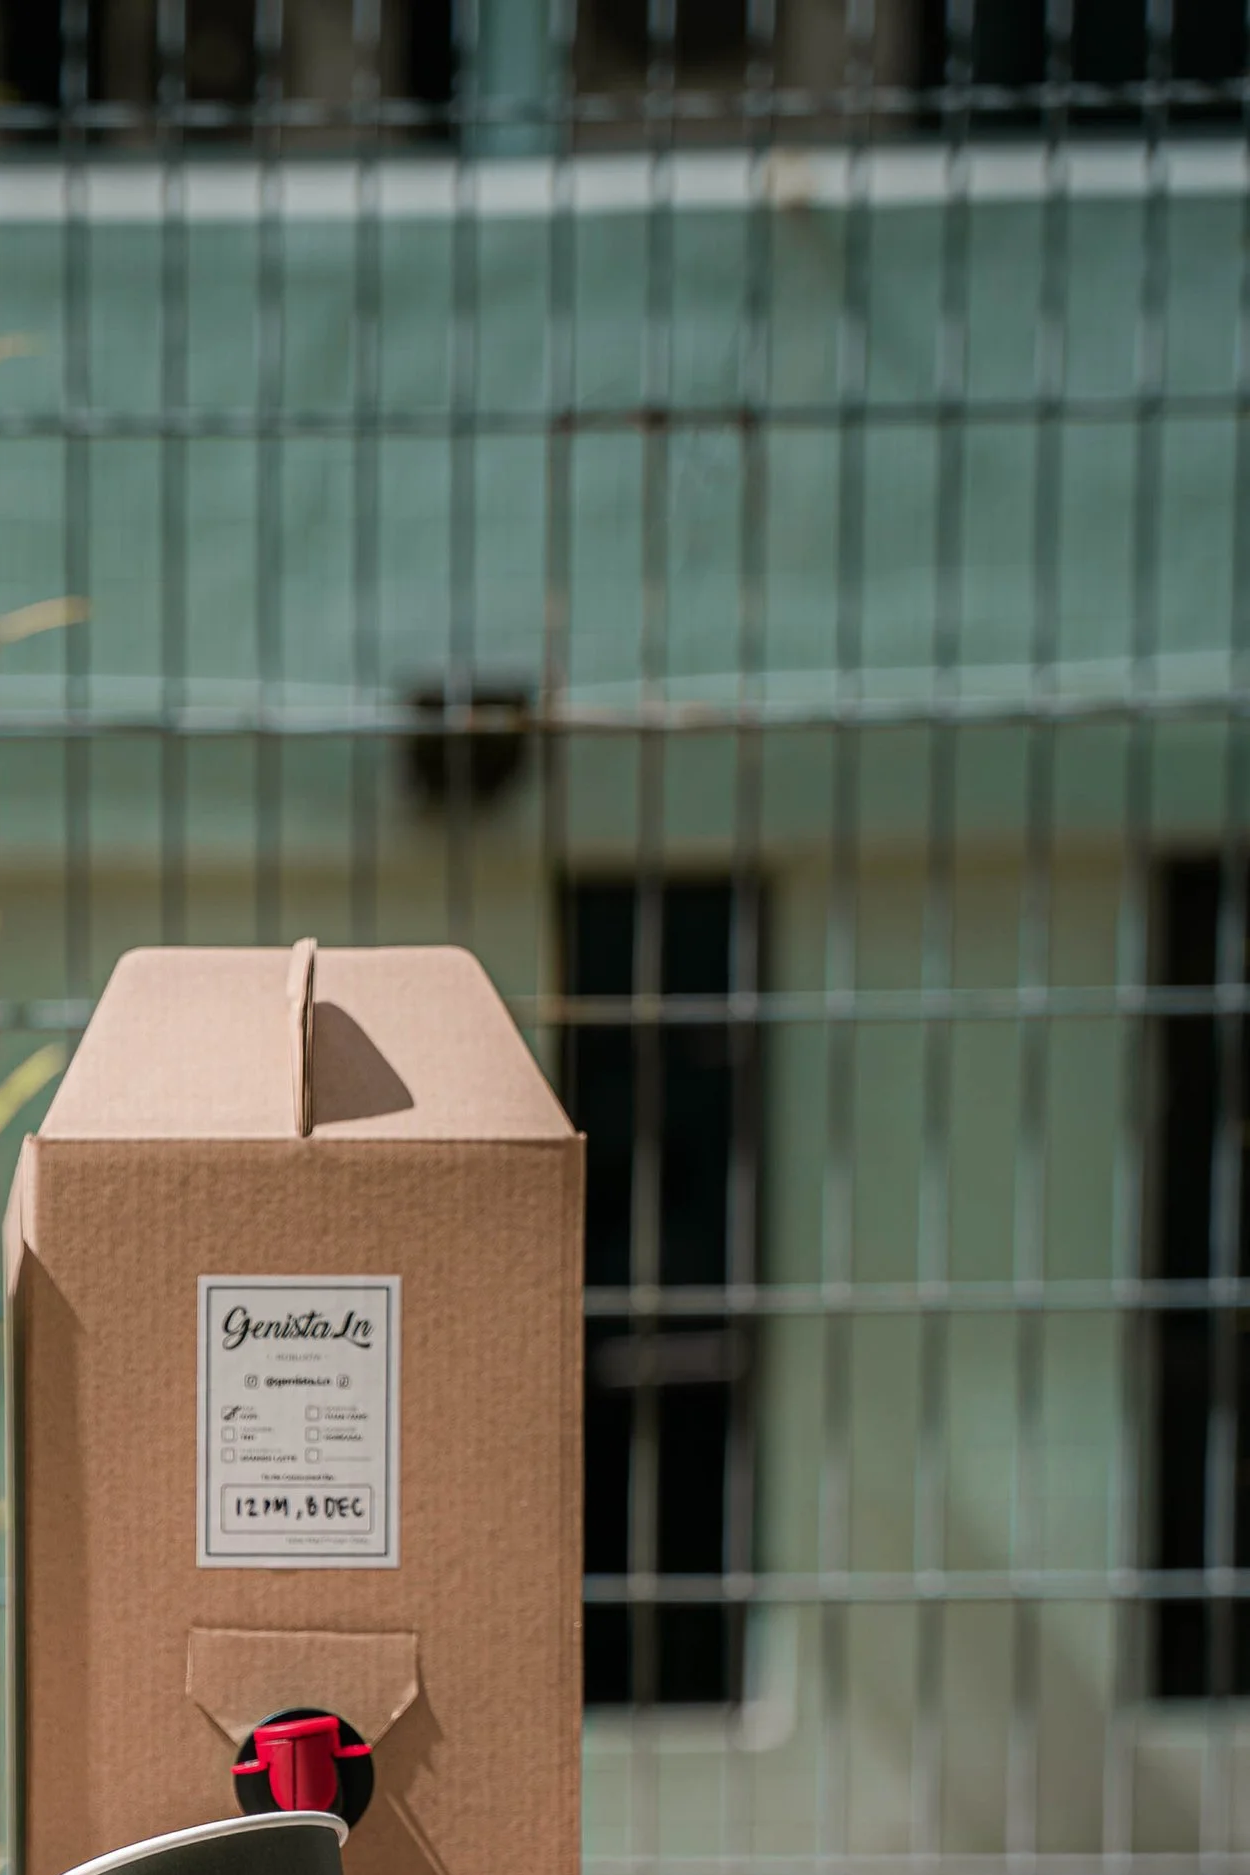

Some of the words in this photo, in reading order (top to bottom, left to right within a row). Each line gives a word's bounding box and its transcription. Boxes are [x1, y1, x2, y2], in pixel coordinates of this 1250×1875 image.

[222, 1305, 332, 1350] Genista
[332, 1309, 373, 1349] Ln
[324, 1496, 365, 1519] DEC
